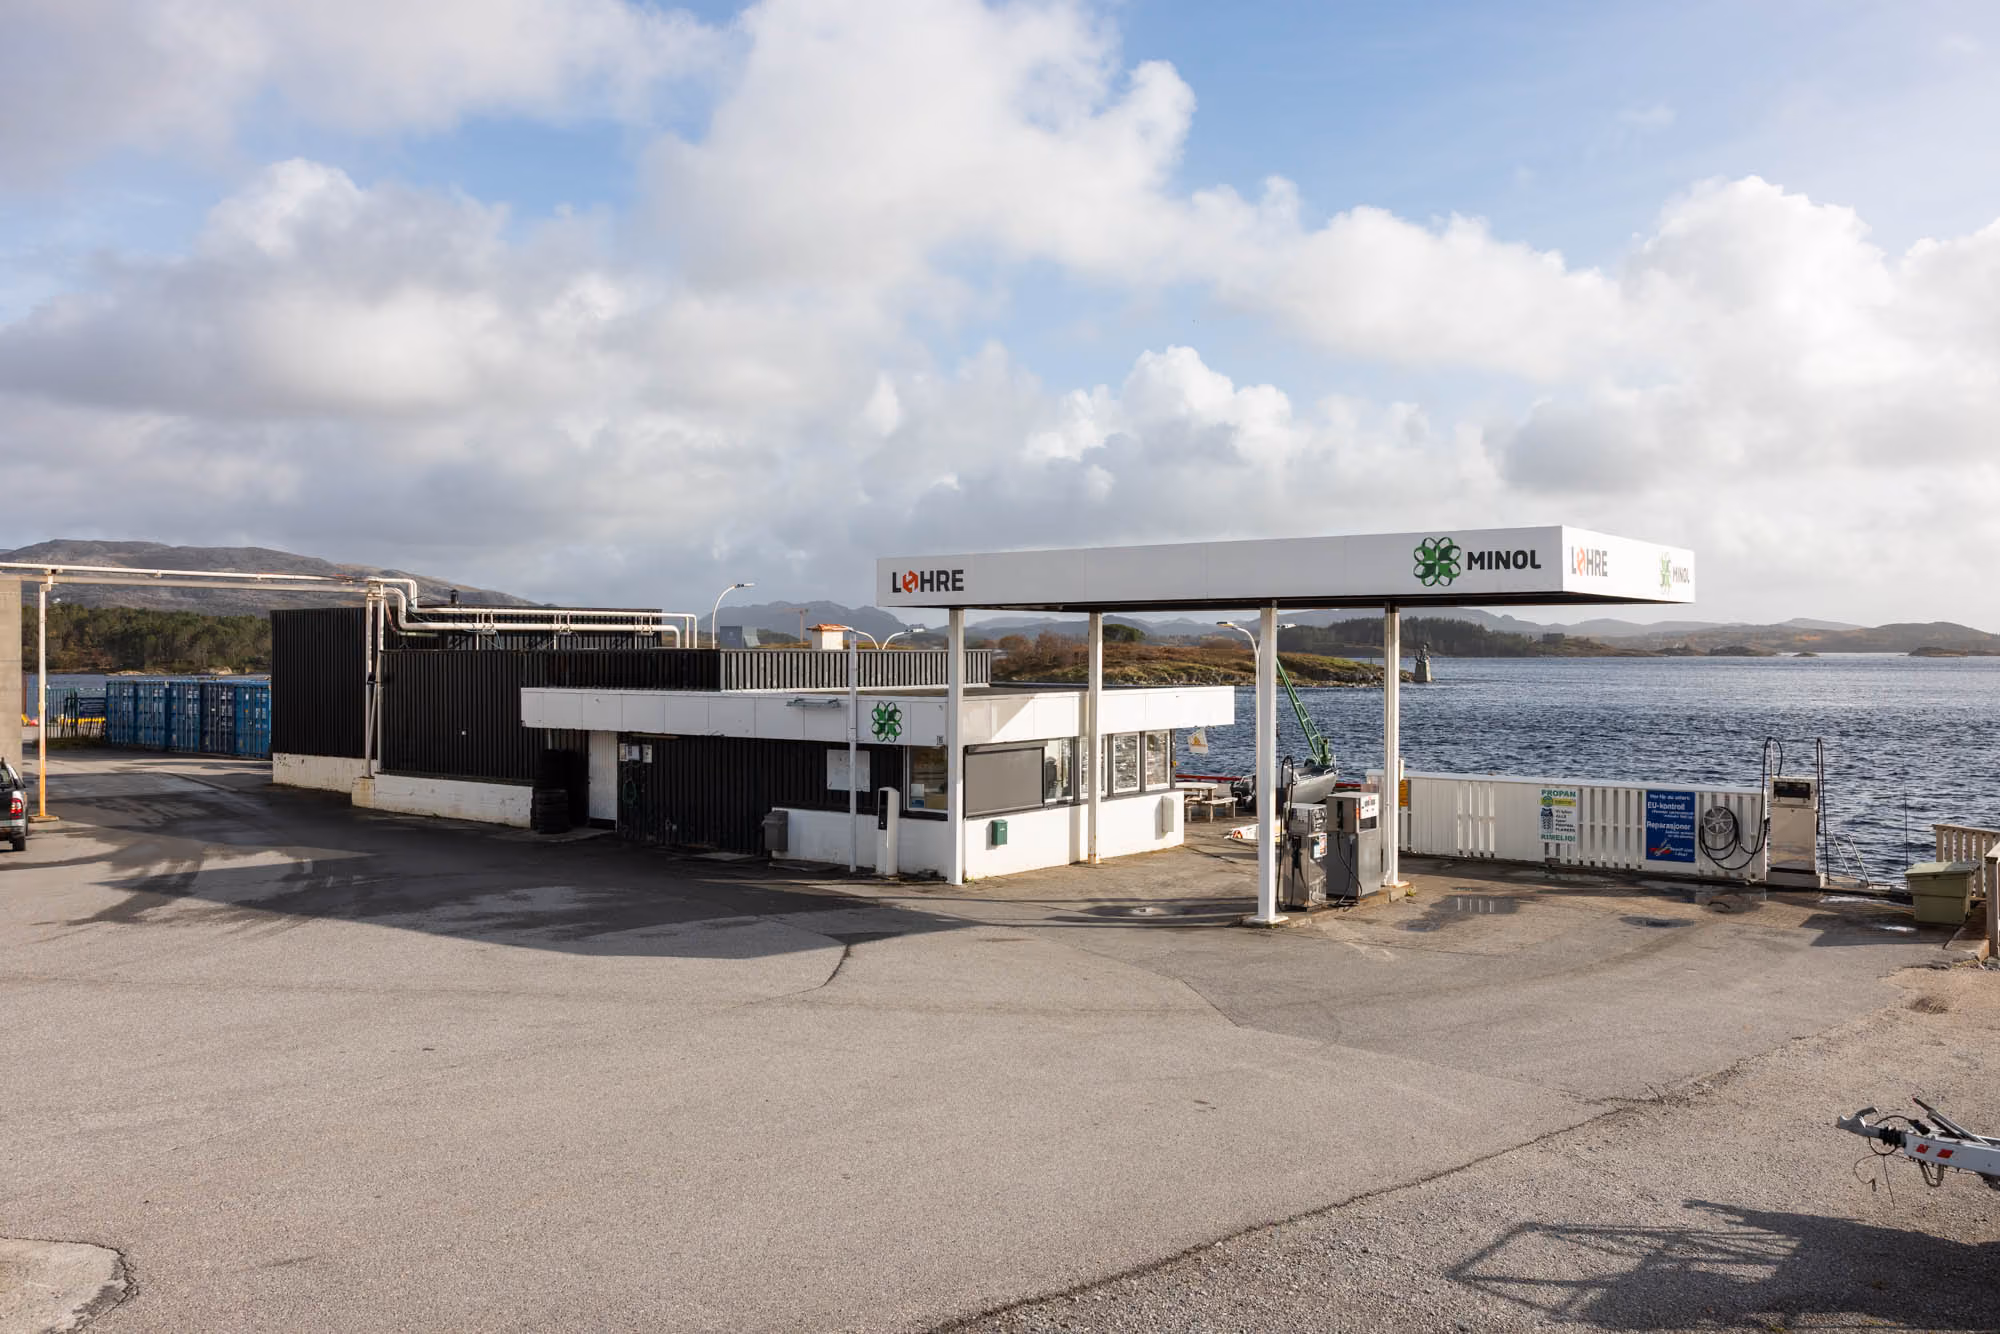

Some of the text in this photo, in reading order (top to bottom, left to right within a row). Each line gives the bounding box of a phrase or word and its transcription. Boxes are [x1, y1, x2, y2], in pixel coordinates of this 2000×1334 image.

[1467, 550, 1541, 570] MINOL
[1672, 567, 1690, 584] MINOL
[1541, 789, 1576, 797] PROPAN
[1647, 801, 1685, 810] EU-kontroll
[1646, 820, 1692, 831] Reparasjoner
